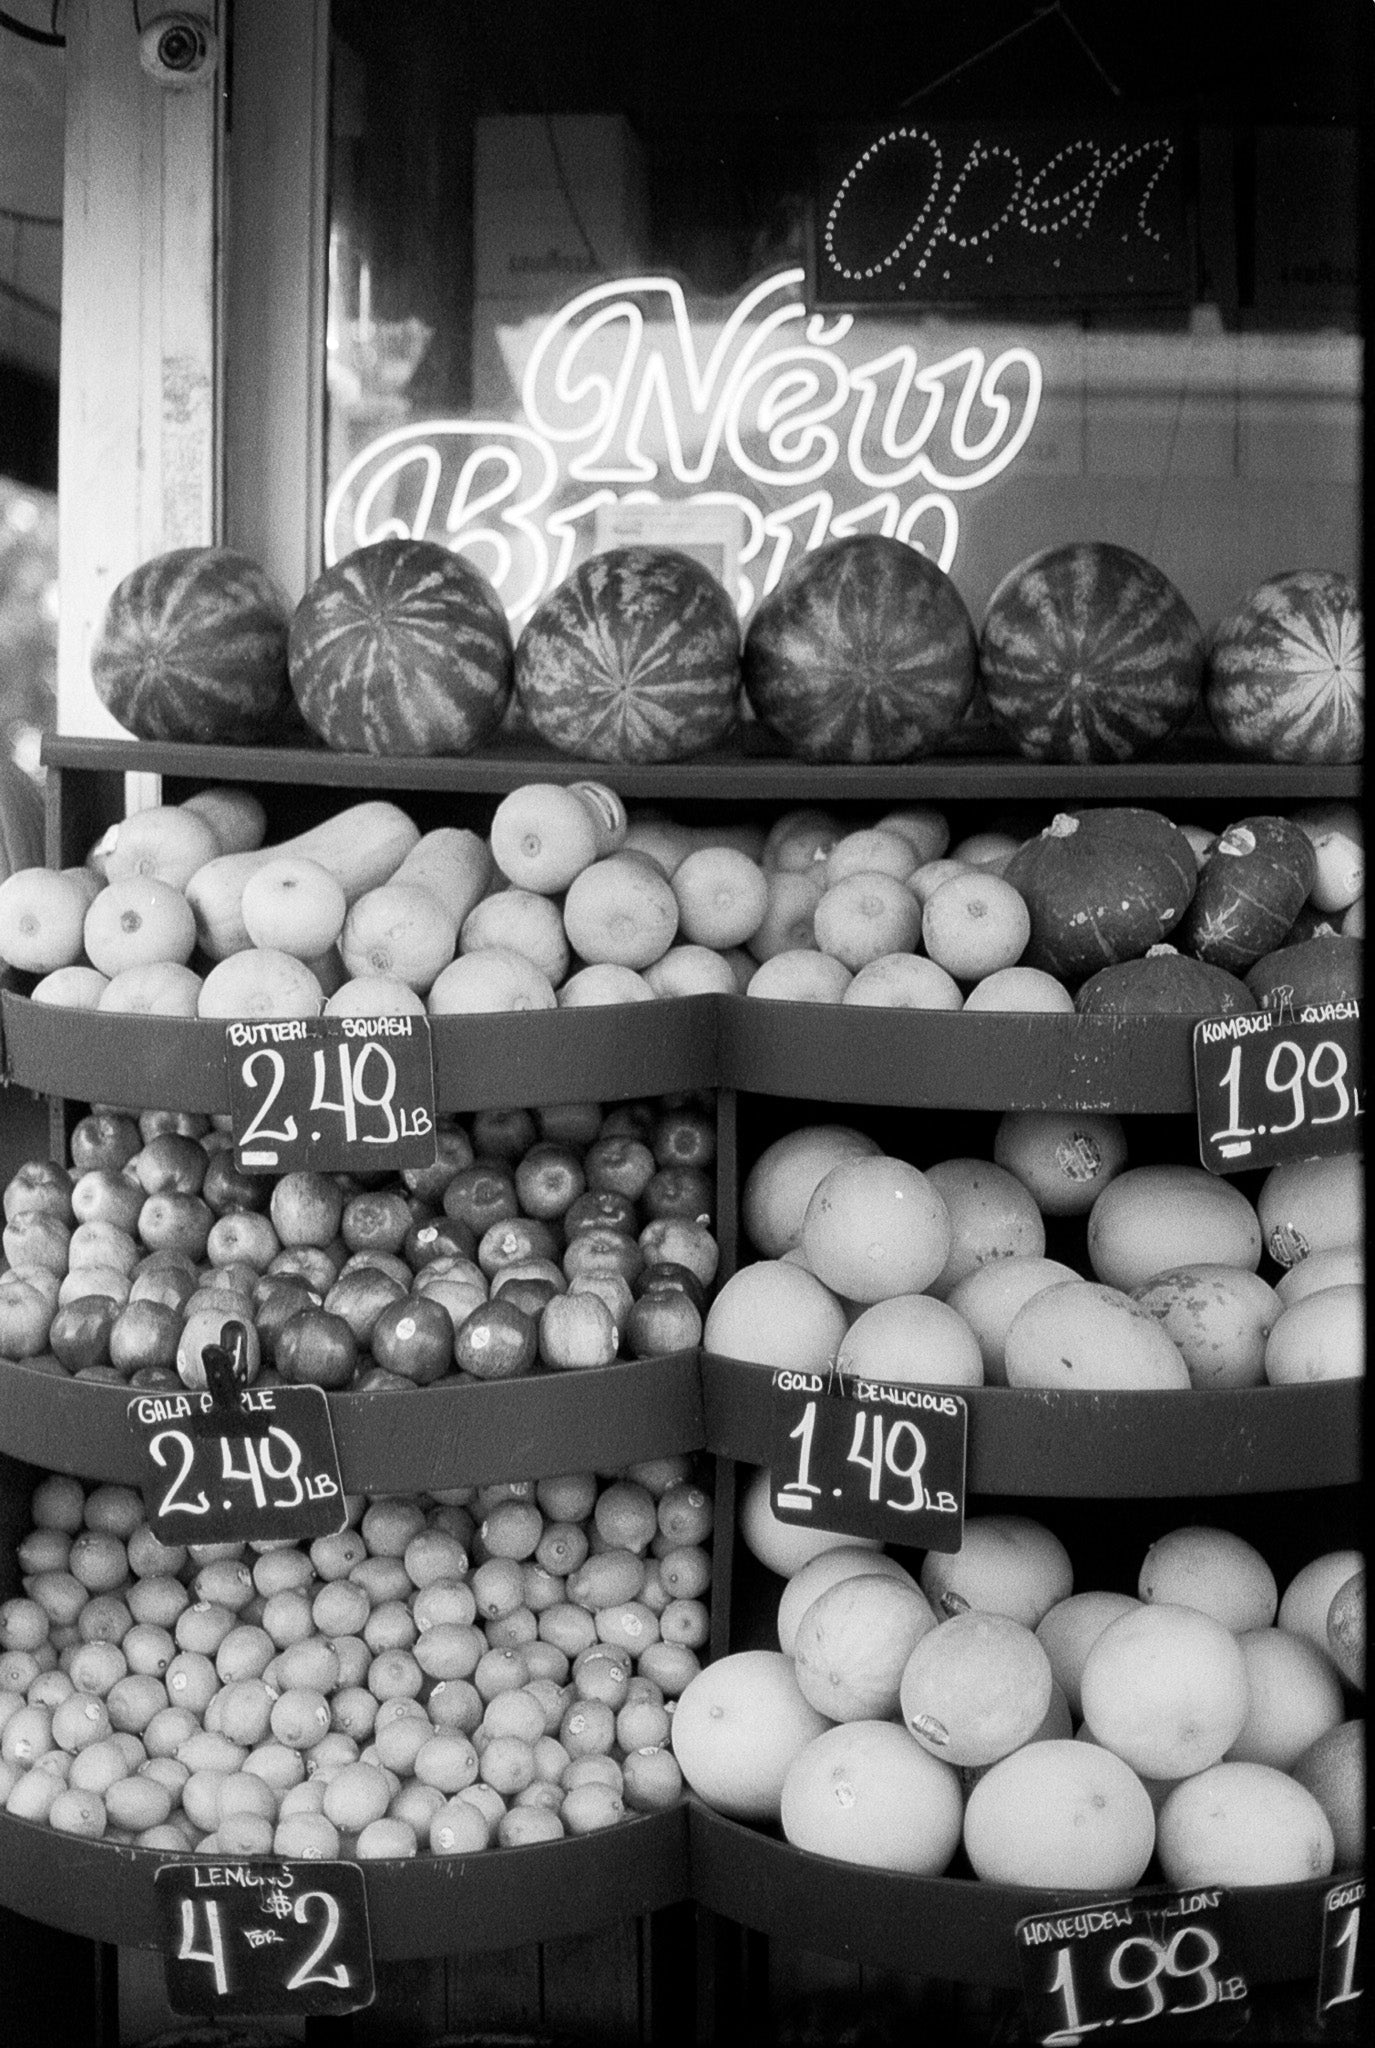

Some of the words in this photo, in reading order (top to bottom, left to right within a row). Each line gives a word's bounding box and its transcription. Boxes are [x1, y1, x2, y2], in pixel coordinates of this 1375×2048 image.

[825, 126, 1175, 279] Open
[524, 268, 1042, 490] New
[341, 1015, 413, 1037] SQUASH
[1202, 1012, 1273, 1044] KOMBUCH
[238, 1041, 399, 1147] 2.49
[399, 1106, 433, 1138] LB
[1209, 1040, 1350, 1142] 1.99
[137, 1395, 192, 1424] GALA
[777, 1370, 823, 1392] GOLD
[149, 1425, 304, 1518] 2.49
[304, 1473, 339, 1500] LB
[783, 1401, 927, 1512] 1.49
[923, 1487, 959, 1513] LB
[177, 1898, 229, 1996] 4
[243, 1928, 285, 1950] FOR
[1022, 1908, 1134, 1947] HONEYDEW
[1042, 1926, 1220, 2044] 1.99
[1216, 1976, 1248, 2003] LB
